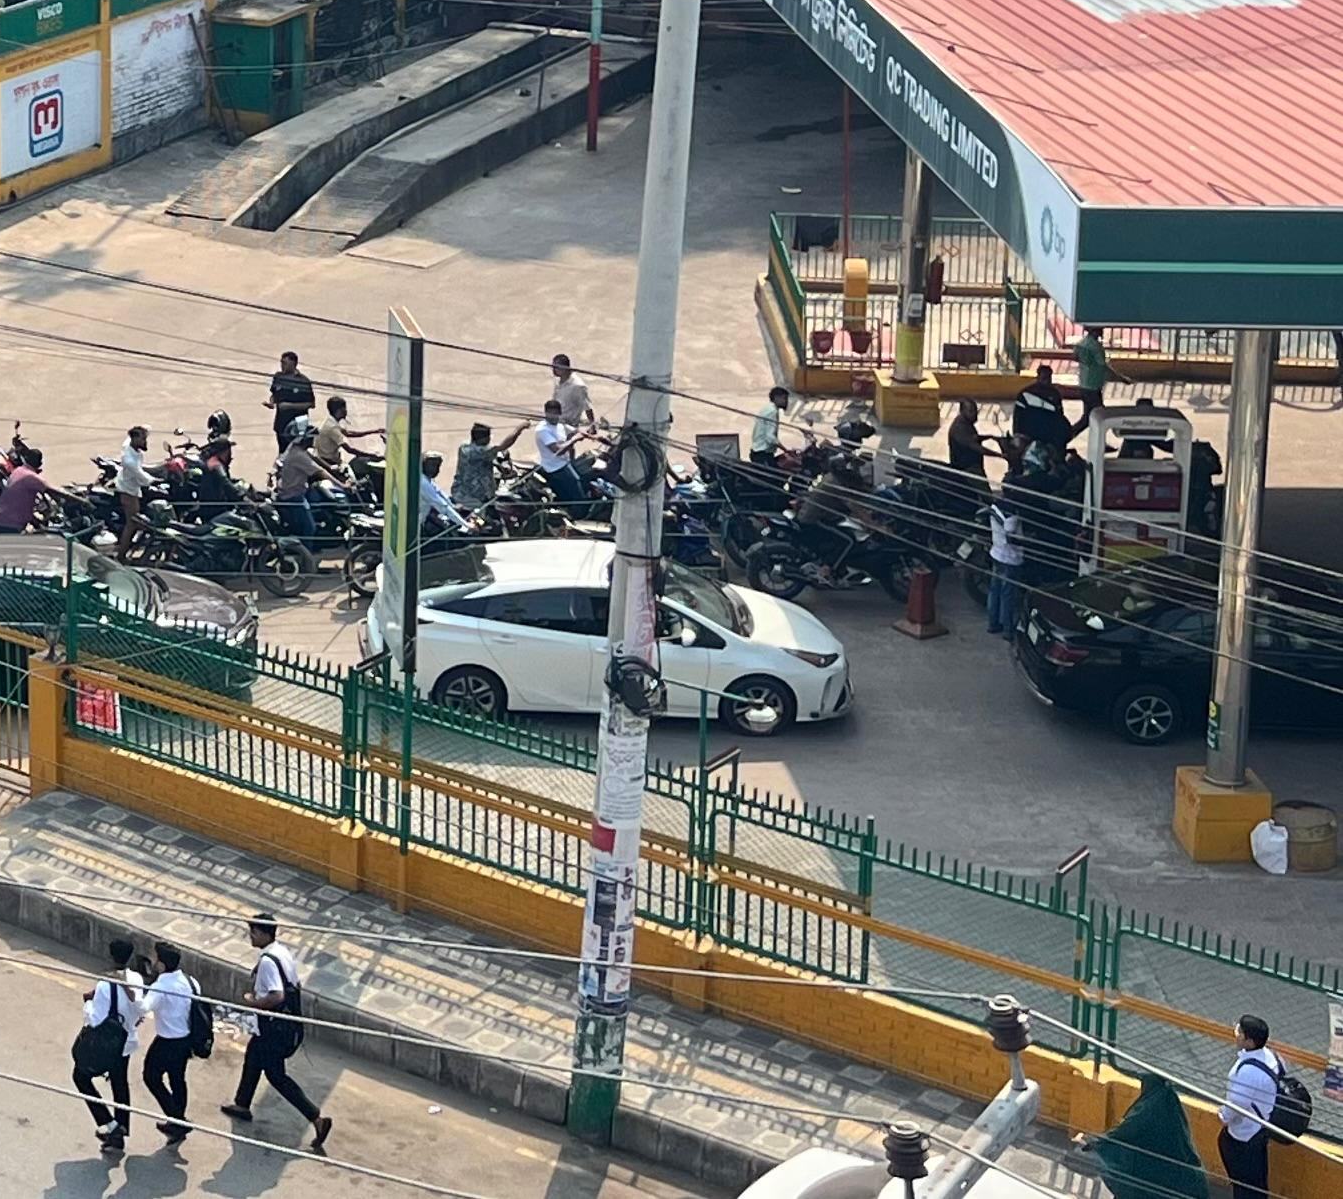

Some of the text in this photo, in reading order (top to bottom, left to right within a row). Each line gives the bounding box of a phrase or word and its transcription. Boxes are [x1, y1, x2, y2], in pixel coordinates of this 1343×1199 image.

[885, 55, 999, 189] QC TRADING LIMITED
